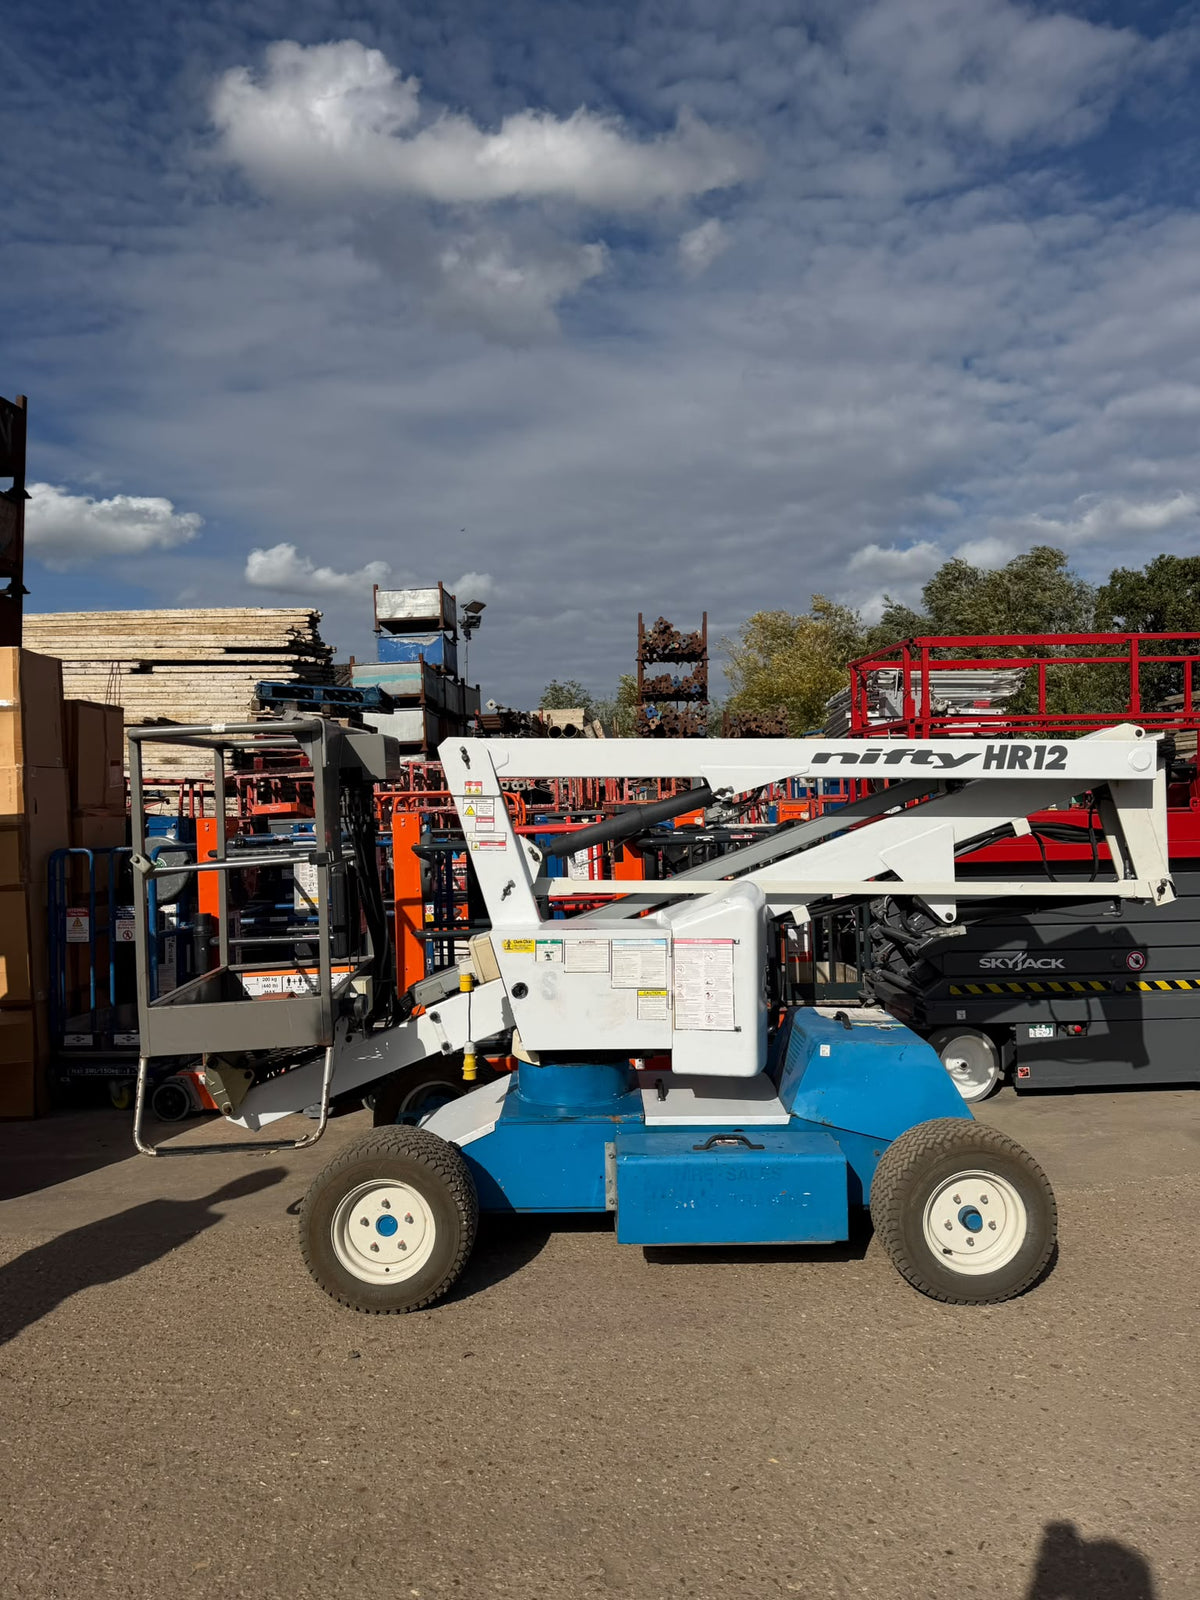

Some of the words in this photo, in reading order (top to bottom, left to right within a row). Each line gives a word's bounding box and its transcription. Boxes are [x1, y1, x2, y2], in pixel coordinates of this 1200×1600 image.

[811, 748, 982, 769] nifty
[982, 744, 1069, 770] HR12
[978, 952, 1066, 971] SKYJACK
